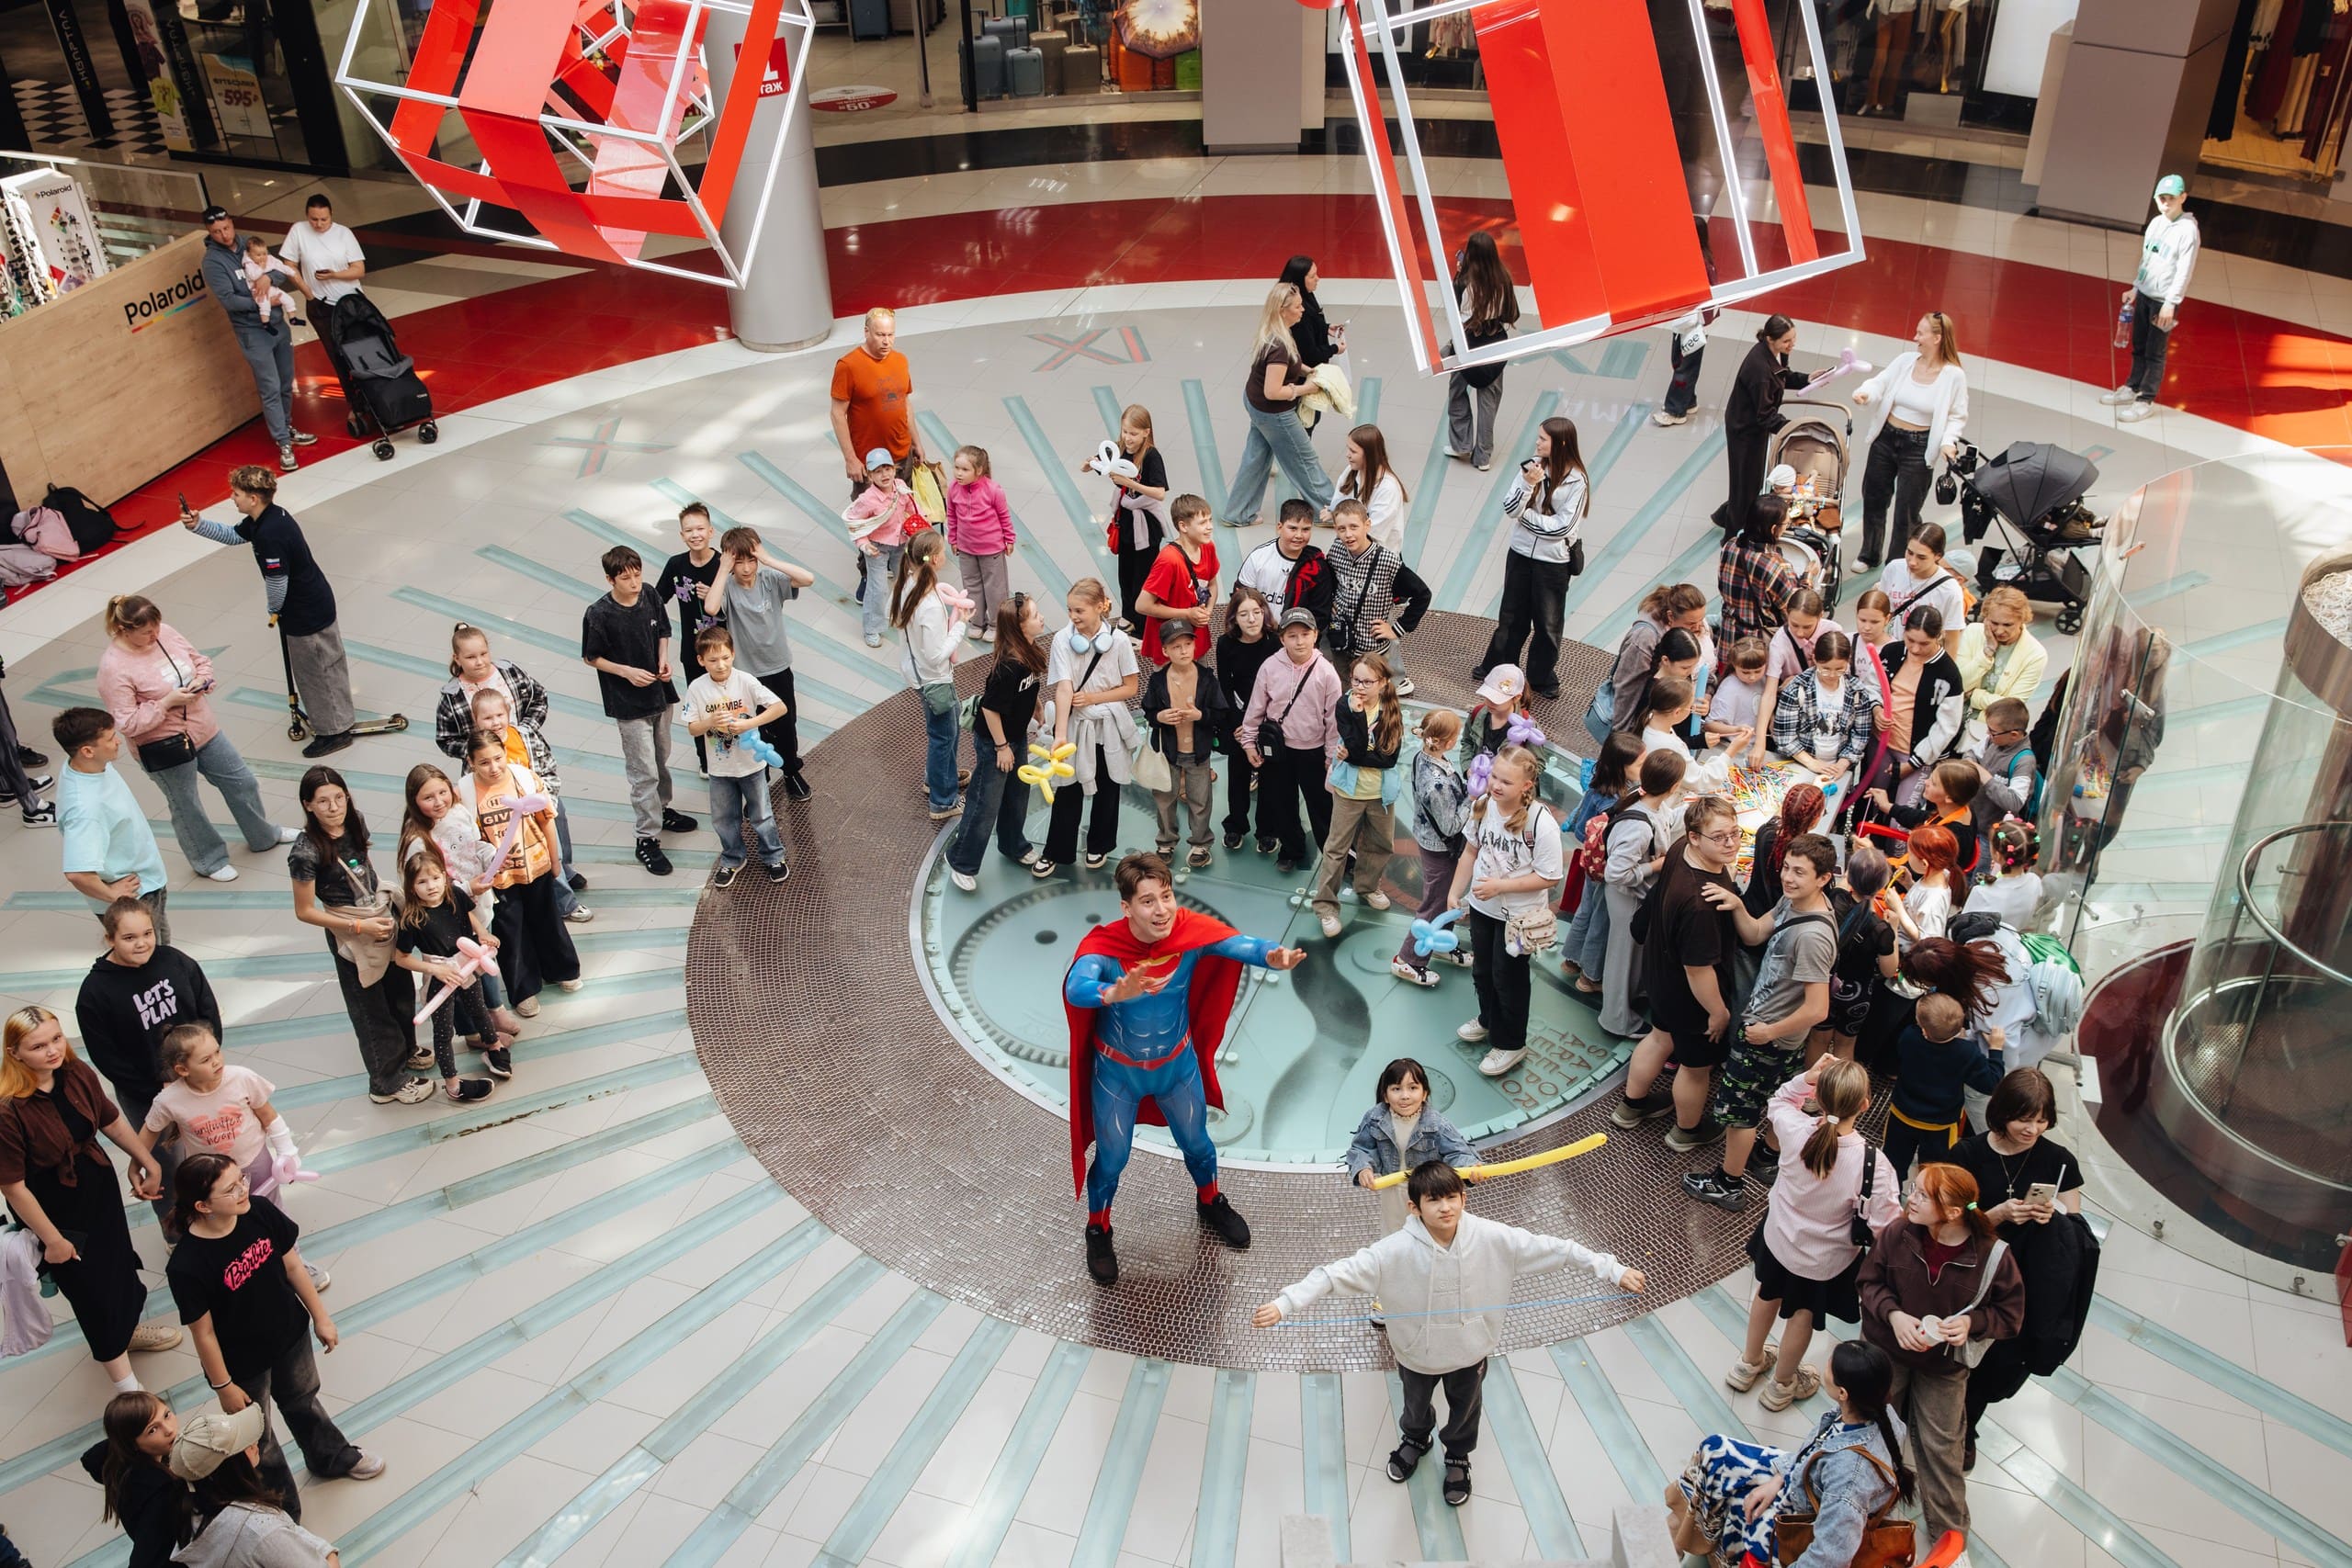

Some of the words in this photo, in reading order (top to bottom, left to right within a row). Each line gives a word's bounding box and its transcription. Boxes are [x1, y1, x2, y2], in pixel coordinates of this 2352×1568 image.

[761, 81, 783, 95] таж
[40, 184, 73, 198] Polaroid
[123, 268, 206, 325] Polaroid
[726, 699, 743, 711] VIBE
[140, 995, 177, 1031] PLAY
[225, 1241, 271, 1290] Barbie
